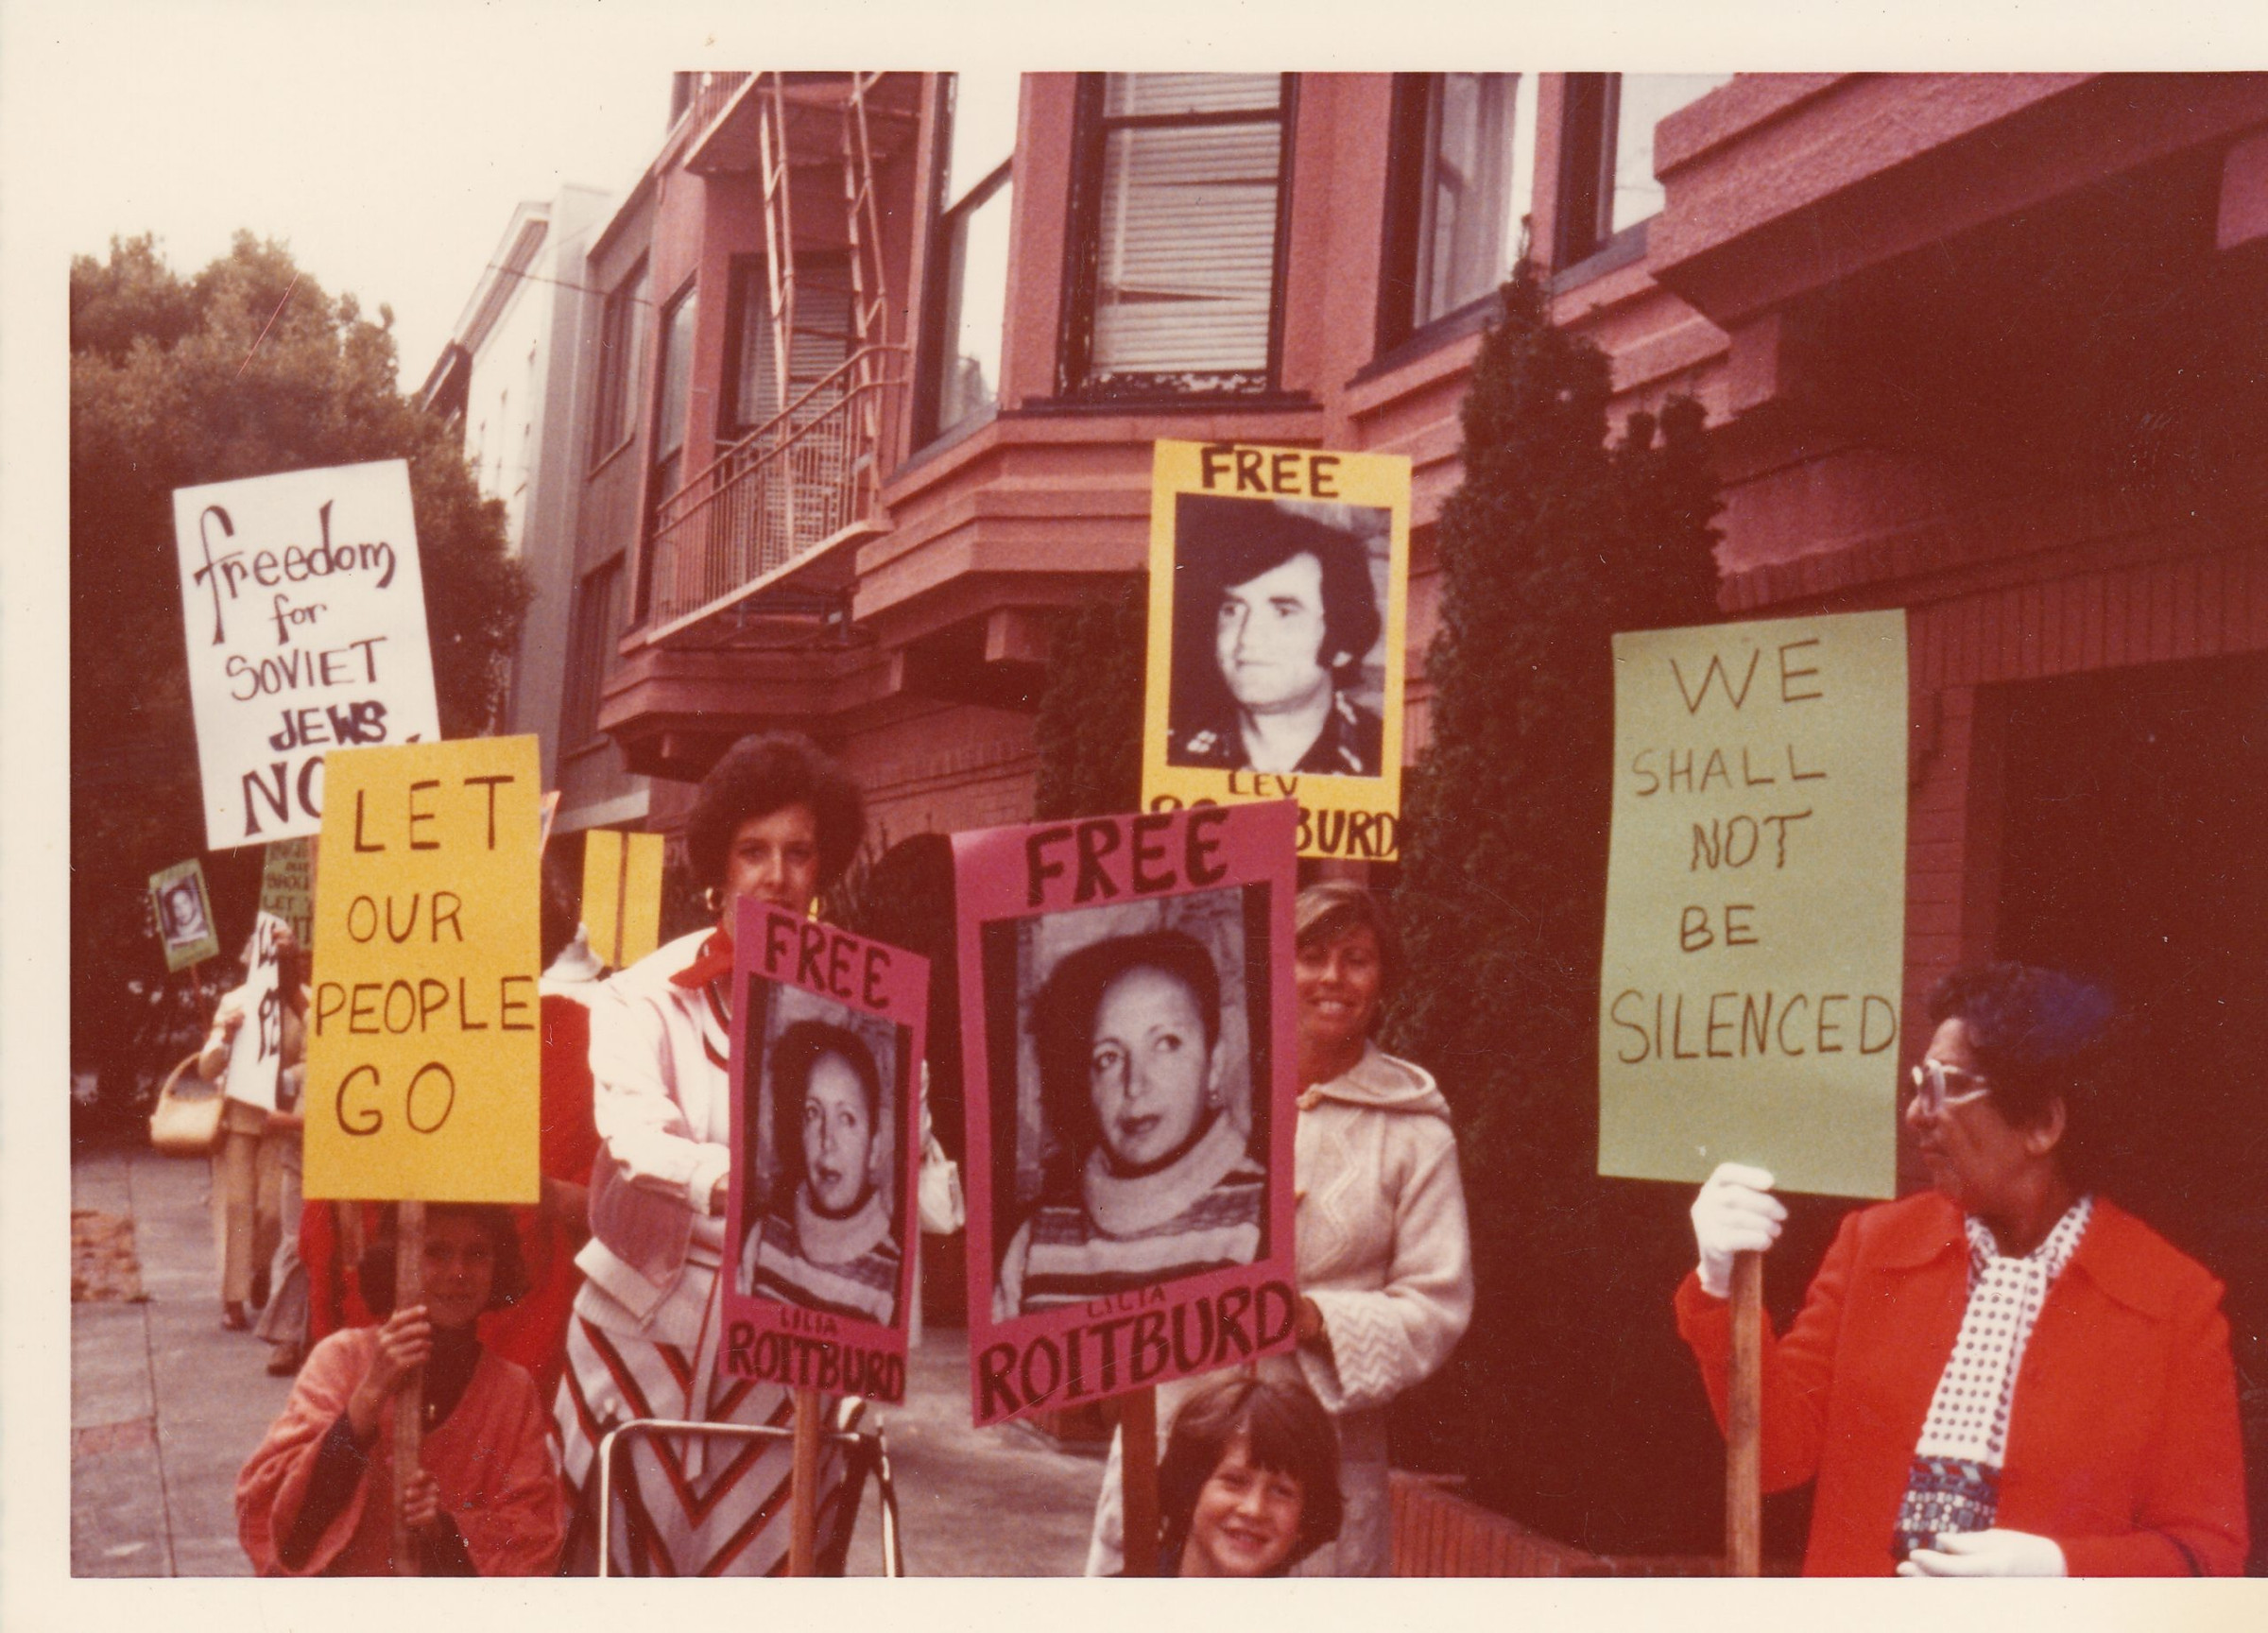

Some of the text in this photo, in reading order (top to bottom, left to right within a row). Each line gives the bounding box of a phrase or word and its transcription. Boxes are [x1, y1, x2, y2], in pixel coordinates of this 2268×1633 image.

[1201, 444, 1340, 498] FREE
[193, 500, 396, 645] freedom
[269, 594, 327, 645] for
[226, 637, 388, 701] SOVIET
[1669, 639, 1824, 715] WE
[268, 700, 387, 751] JEWS
[1228, 771, 1298, 797] LEV
[1632, 745, 1827, 797] SHALL
[353, 775, 514, 851] LET
[1691, 809, 1813, 871] NOT
[1025, 808, 1229, 908] FREE
[347, 890, 464, 943] OUR
[1680, 904, 1760, 953] BE
[764, 913, 891, 1010] FREE
[315, 974, 537, 1038] PEOPLE
[1610, 988, 1898, 1064] SILENCED
[335, 1062, 455, 1136] GO
[728, 1320, 905, 1402] ROITBURD
[978, 1280, 1295, 1419] ROITBURD
